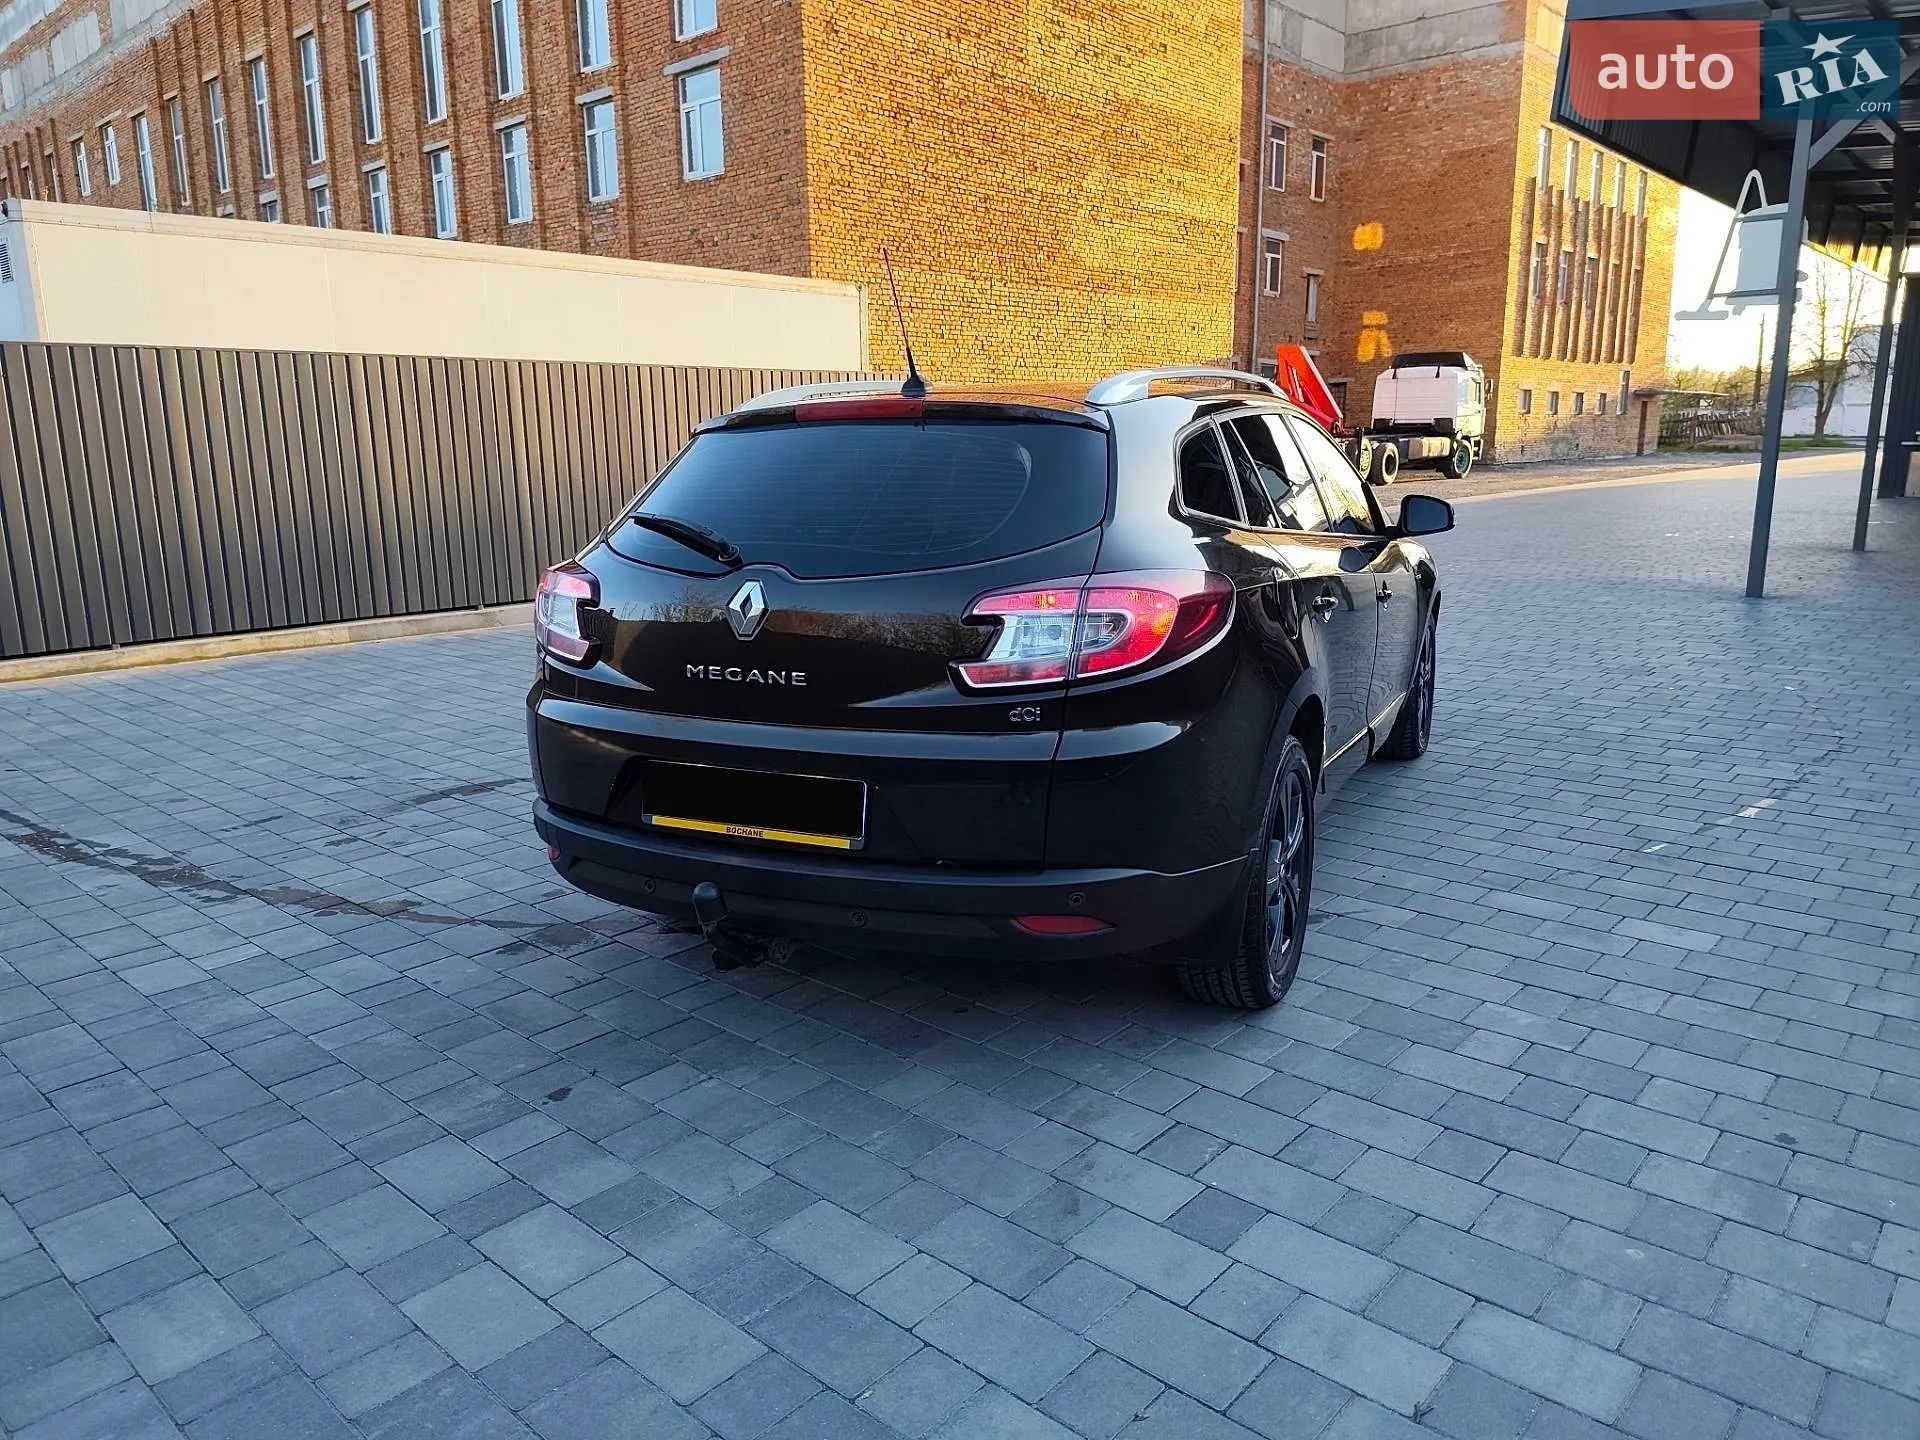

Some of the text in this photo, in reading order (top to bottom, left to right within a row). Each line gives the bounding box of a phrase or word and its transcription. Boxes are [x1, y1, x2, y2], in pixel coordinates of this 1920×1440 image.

[686, 664, 807, 686] MEGANE
[1009, 707, 1041, 722] dCi
[726, 826, 764, 838] BOCHANE
